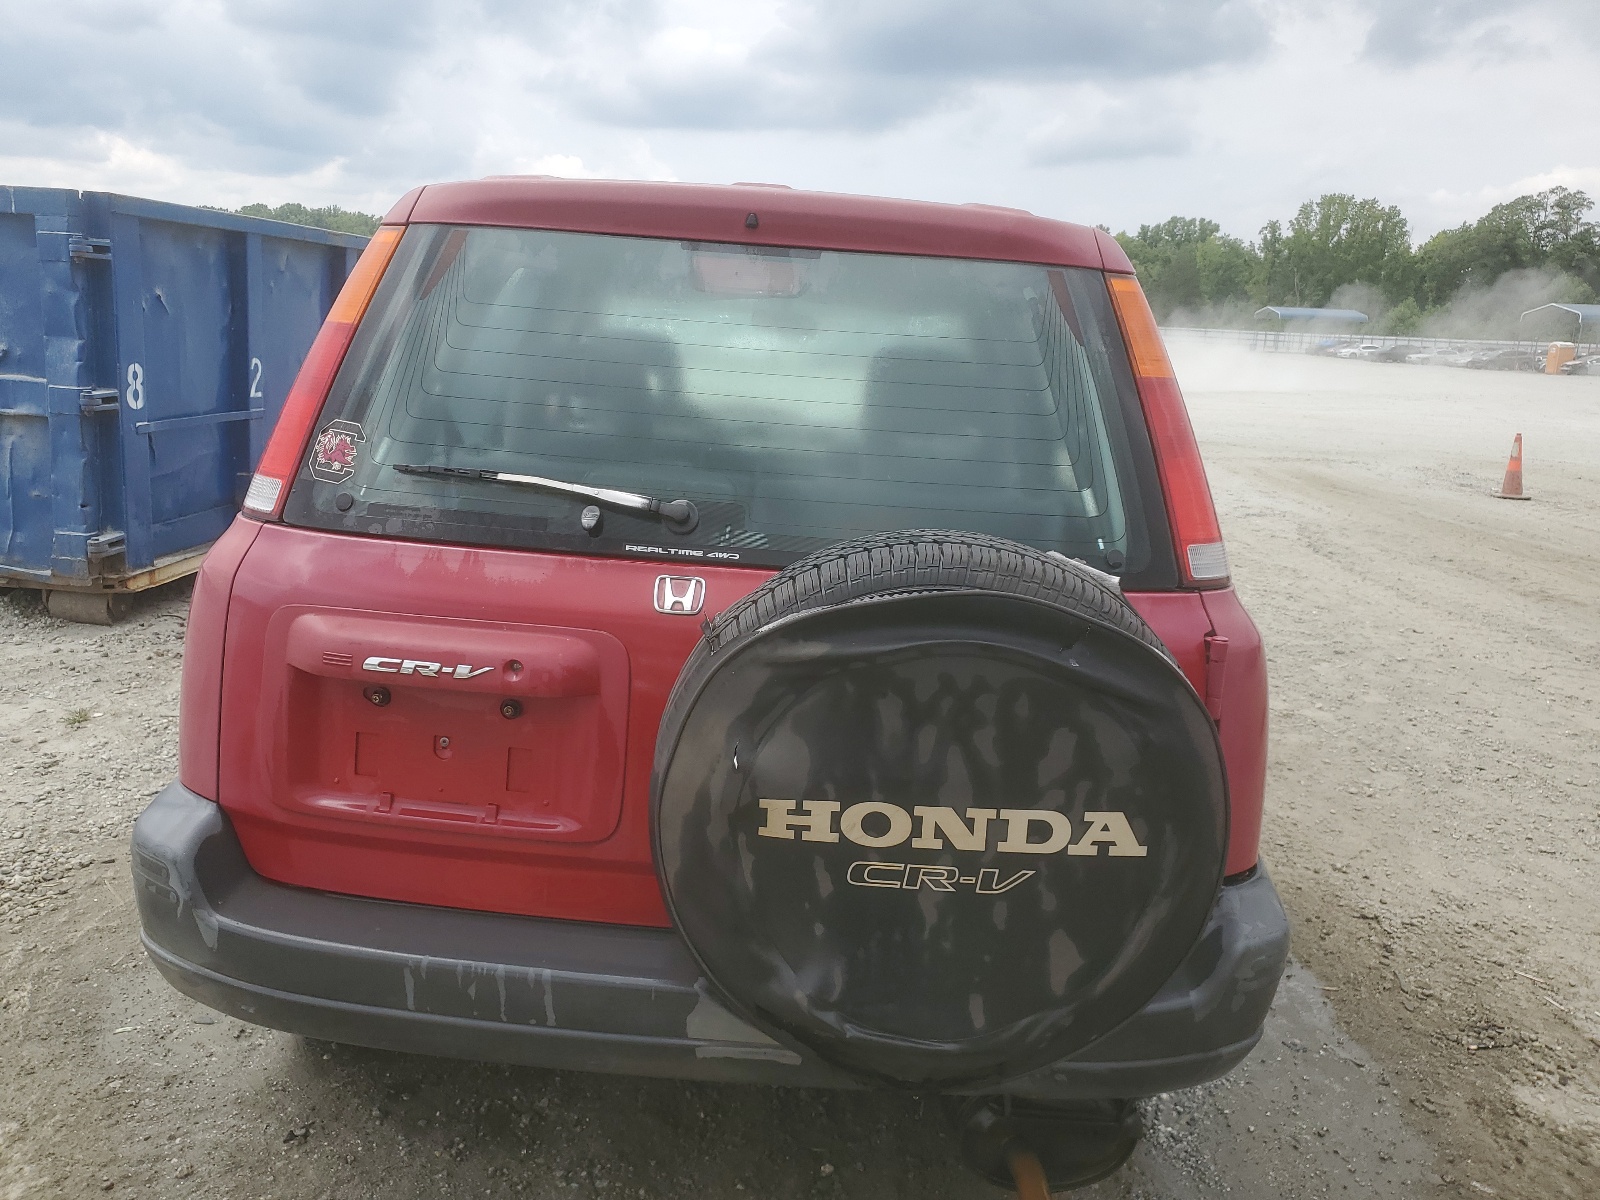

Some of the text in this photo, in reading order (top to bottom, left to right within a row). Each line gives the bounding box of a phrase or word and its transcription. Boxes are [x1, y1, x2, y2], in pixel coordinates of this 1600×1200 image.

[126, 357, 263, 410] 8 2
[706, 552, 740, 560] 4WD
[362, 656, 495, 679] CR-V
[758, 798, 1148, 857] HONDA
[847, 860, 1036, 894] CR-V
